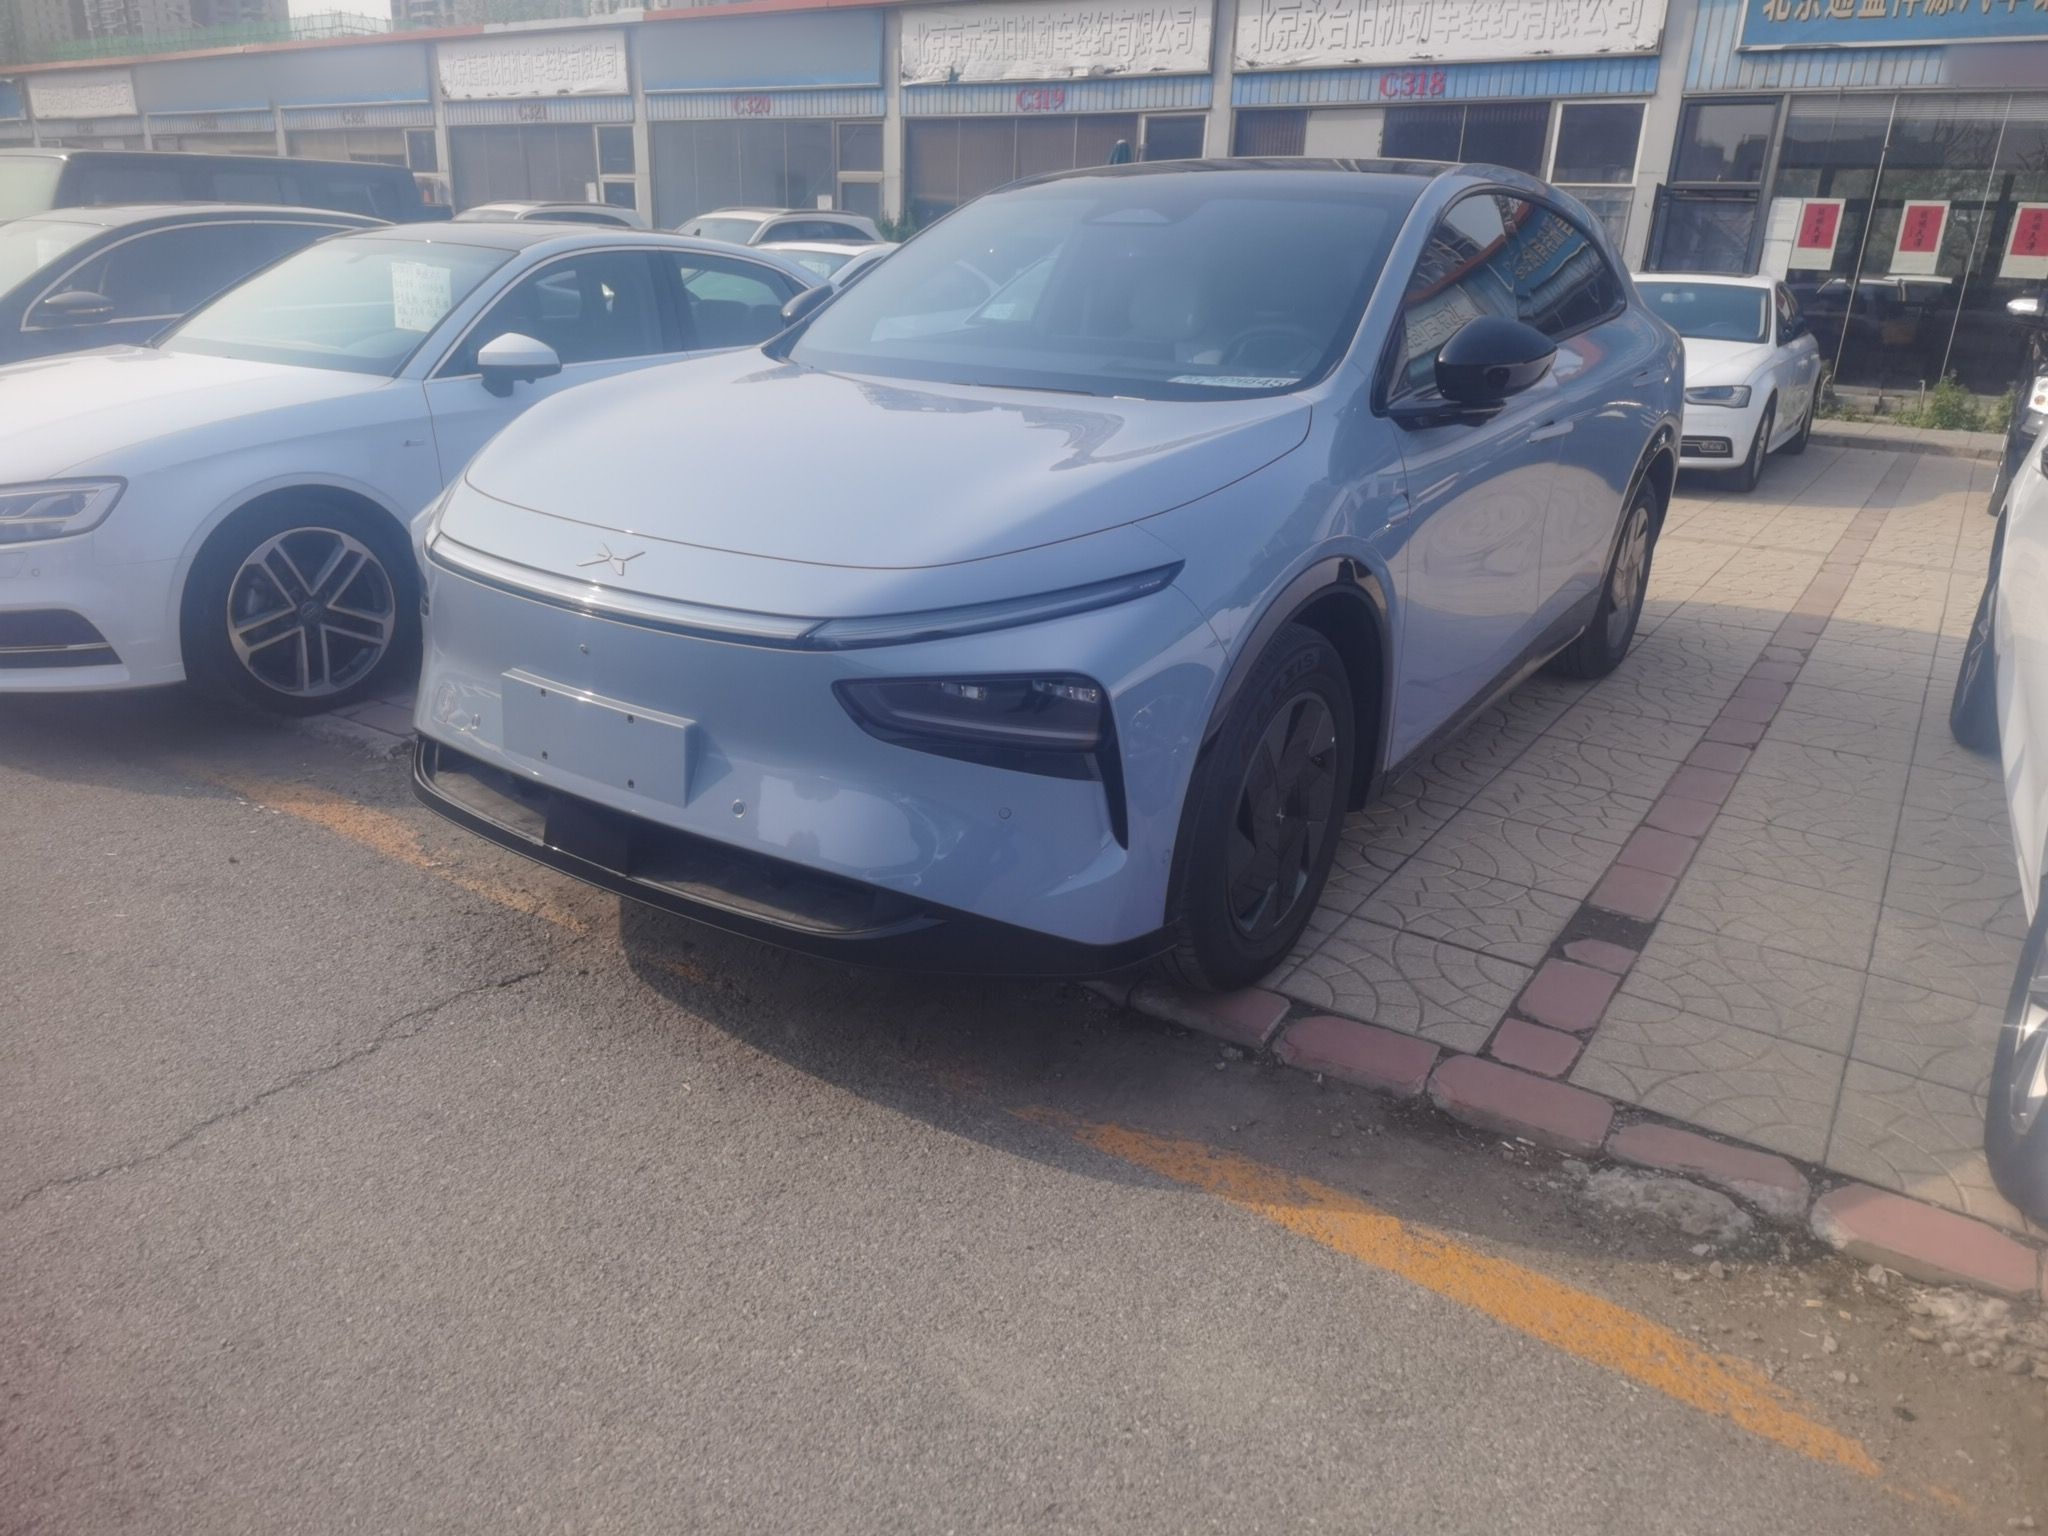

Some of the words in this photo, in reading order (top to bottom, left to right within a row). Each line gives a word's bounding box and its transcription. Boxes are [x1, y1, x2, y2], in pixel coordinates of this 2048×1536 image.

[1380, 71, 1445, 97] C318
[733, 95, 770, 115] C320
[1015, 87, 1065, 111] C319
